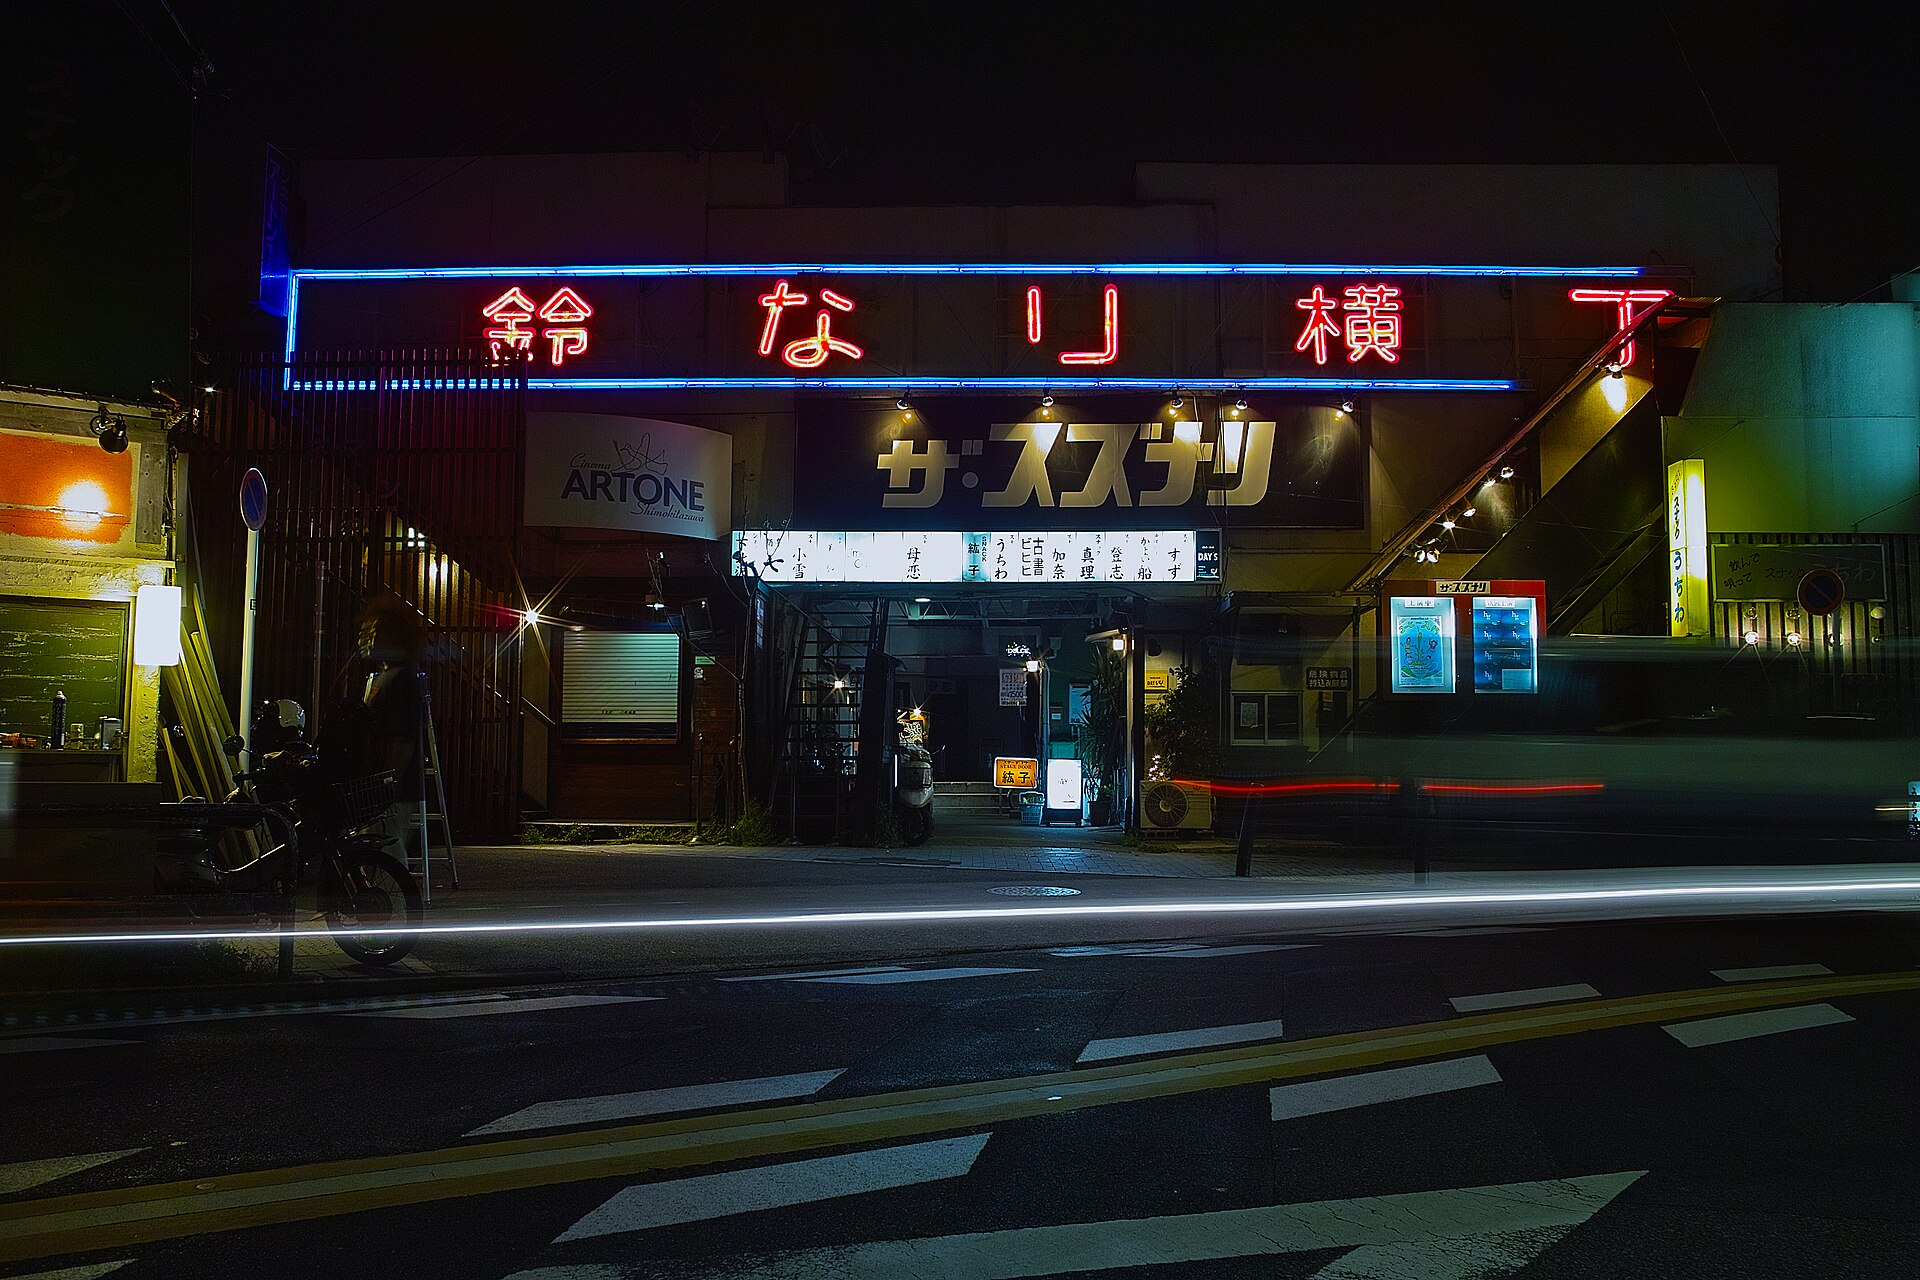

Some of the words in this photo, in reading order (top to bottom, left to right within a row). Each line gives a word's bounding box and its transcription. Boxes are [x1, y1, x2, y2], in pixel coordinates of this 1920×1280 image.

[570, 453, 611, 470] Cinema
[560, 469, 704, 512] ARTONE
[630, 502, 704, 522] Shimokitazawa
[793, 547, 807, 579] 小雪
[907, 547, 922, 580] 母恋
[995, 538, 1008, 580] うちわ
[1033, 537, 1044, 576] 古書
[1052, 547, 1066, 579] 加奈
[1080, 546, 1095, 580] 真理
[1110, 547, 1124, 580] 登志
[1168, 547, 1181, 580] すず
[1674, 551, 1685, 623] うちわ
